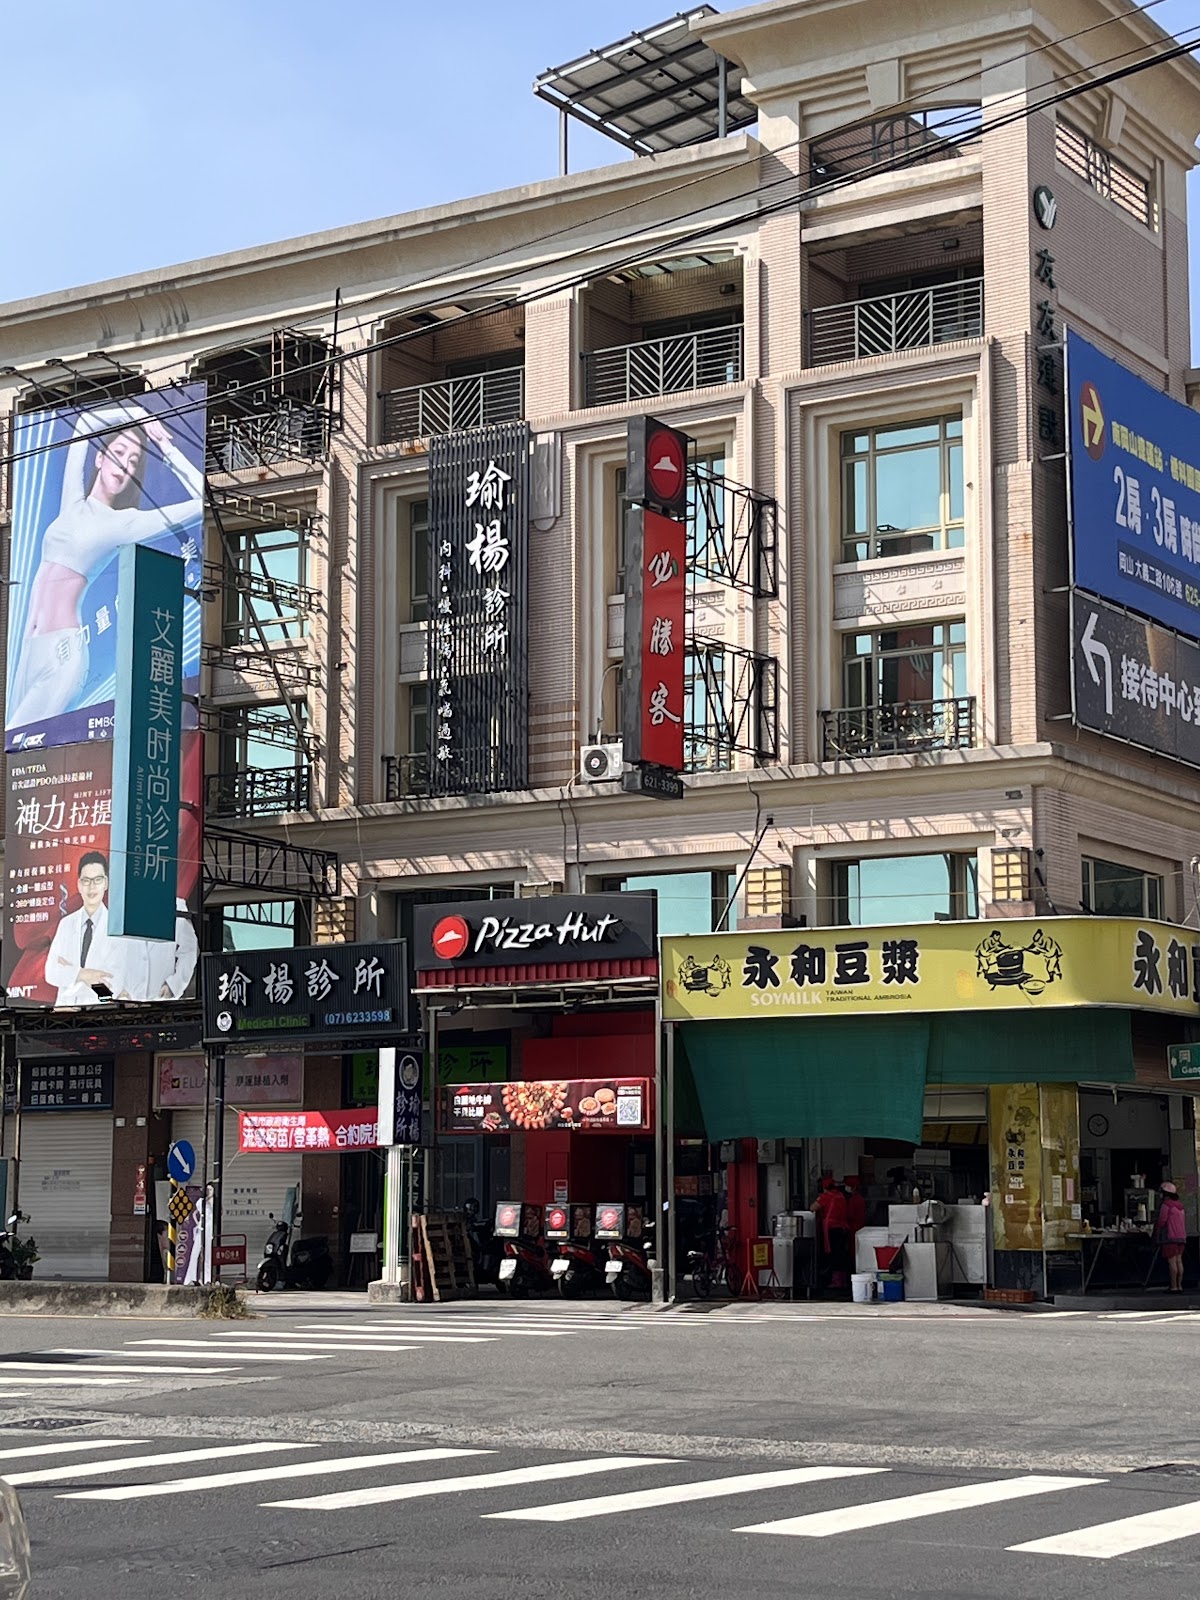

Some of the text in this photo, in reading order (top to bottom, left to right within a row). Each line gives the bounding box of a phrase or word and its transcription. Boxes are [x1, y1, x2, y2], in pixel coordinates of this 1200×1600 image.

[465, 460, 511, 654] 瑜楊診所
[648, 551, 681, 726] 必勝客
[644, 775, 679, 794] 621-3399
[474, 911, 619, 953] Pizza Hut
[217, 956, 385, 1007] 瑜楊診所
[742, 940, 920, 989] 永和豆漿
[750, 991, 822, 1006] SOYMILK
[238, 1017, 277, 1030] Medical
[278, 1015, 308, 1027] Clinic
